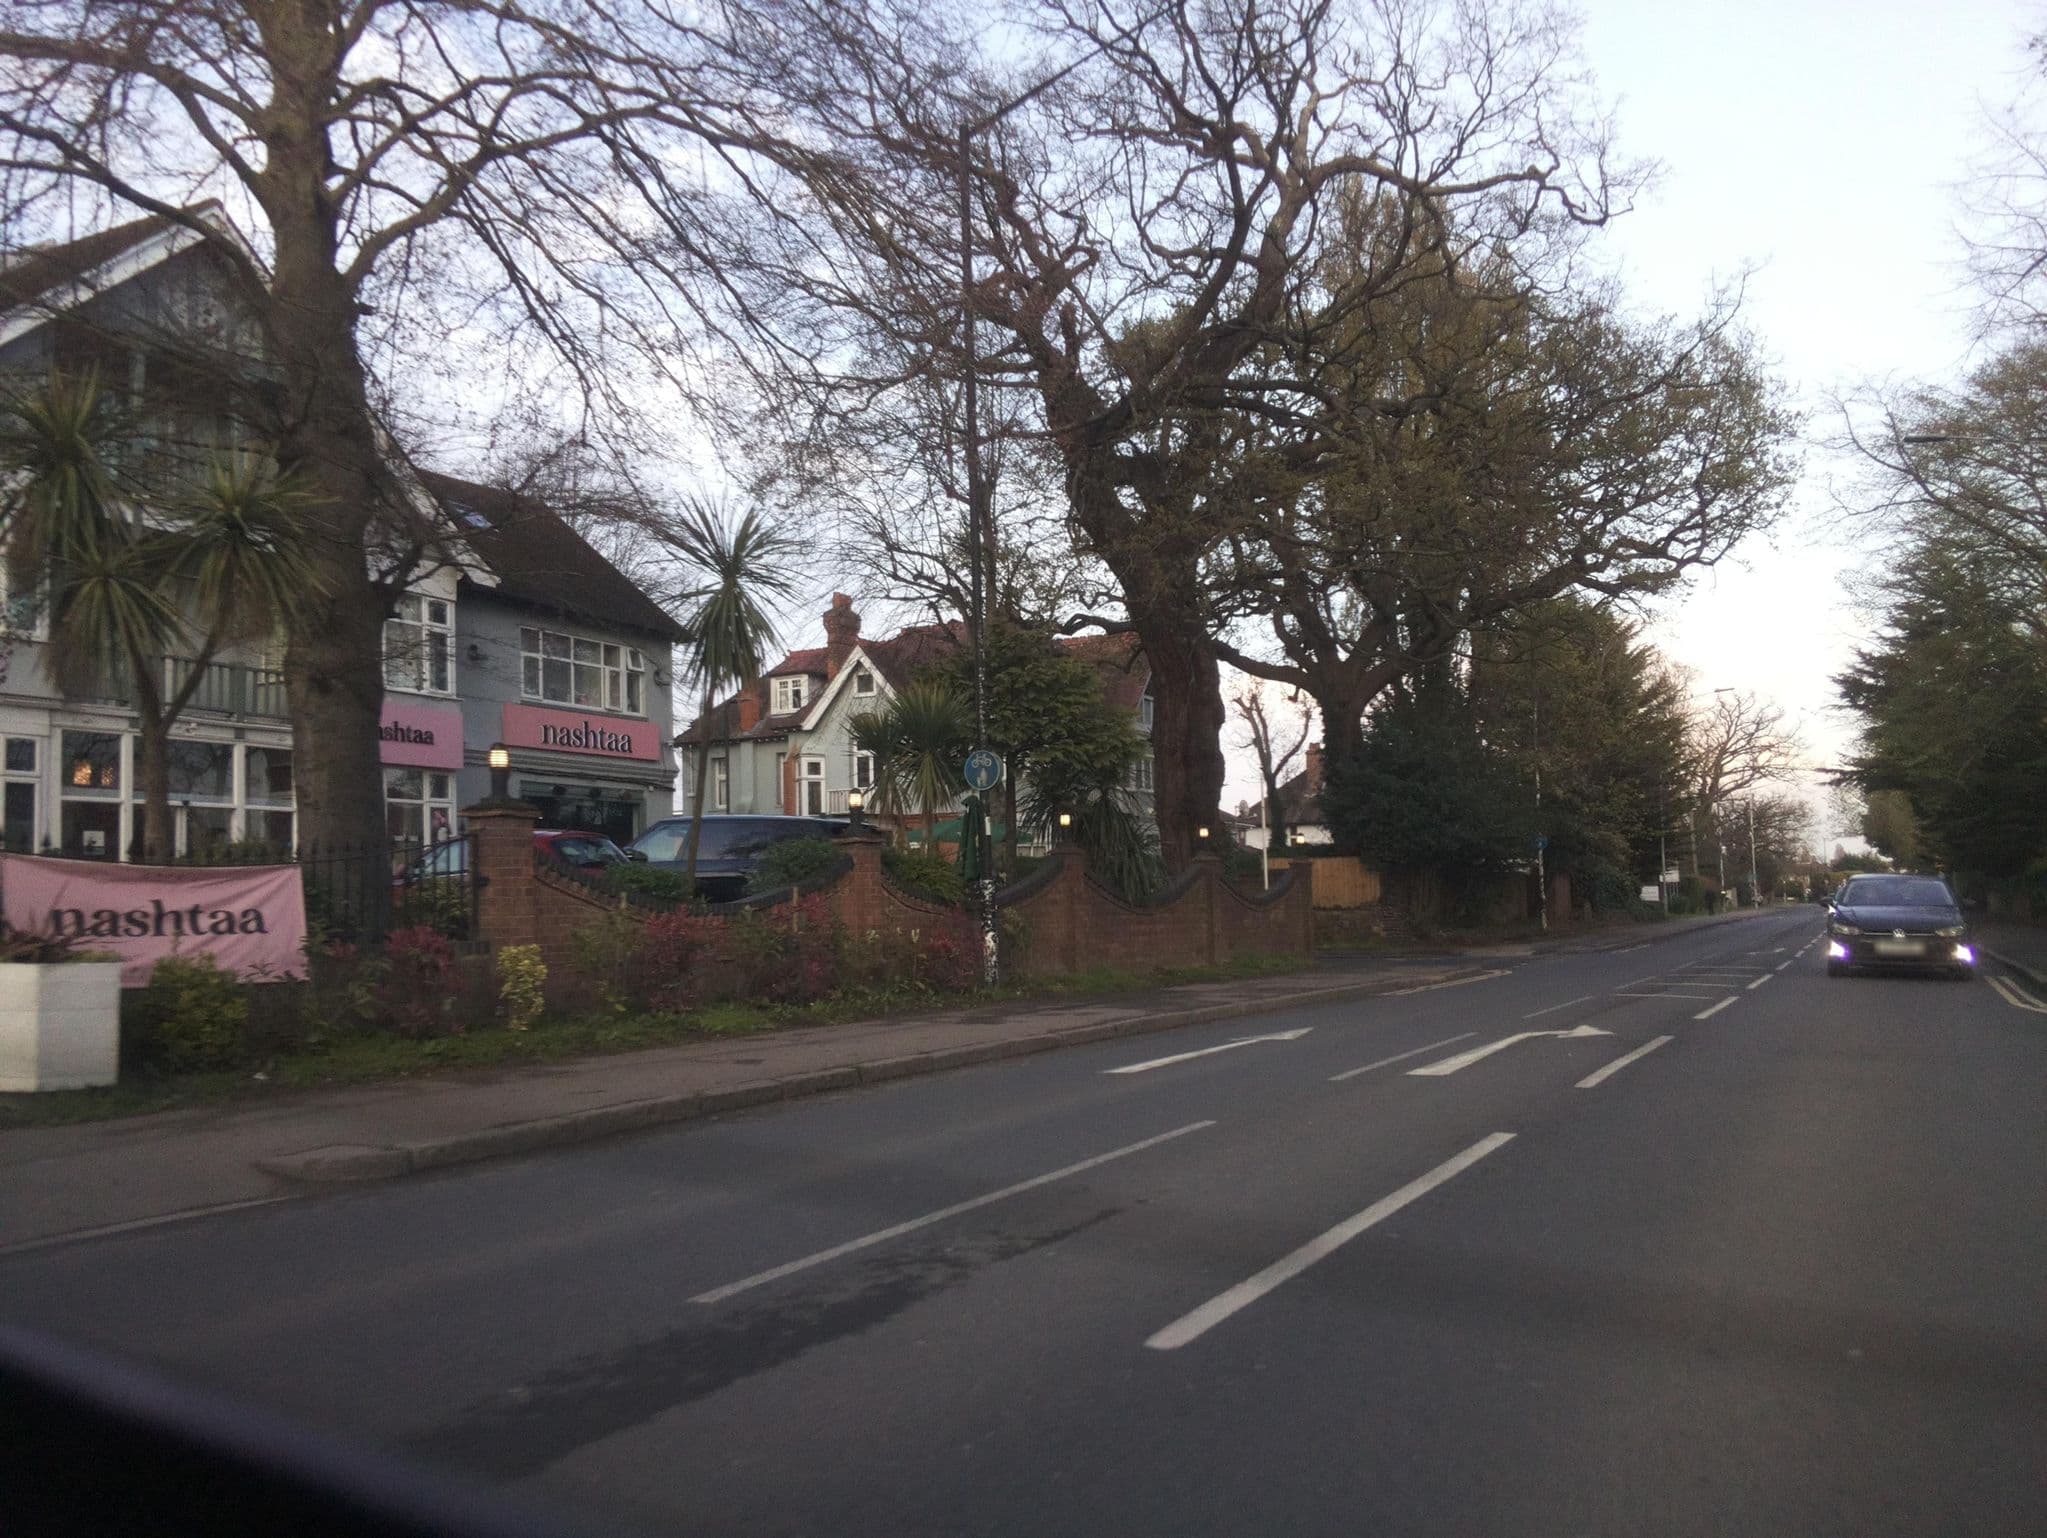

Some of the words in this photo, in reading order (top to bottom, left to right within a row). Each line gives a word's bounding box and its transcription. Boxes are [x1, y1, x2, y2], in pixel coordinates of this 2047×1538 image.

[378, 721, 435, 745] shtaa
[540, 721, 632, 753] nashtaa
[51, 899, 268, 937] nashtaa
